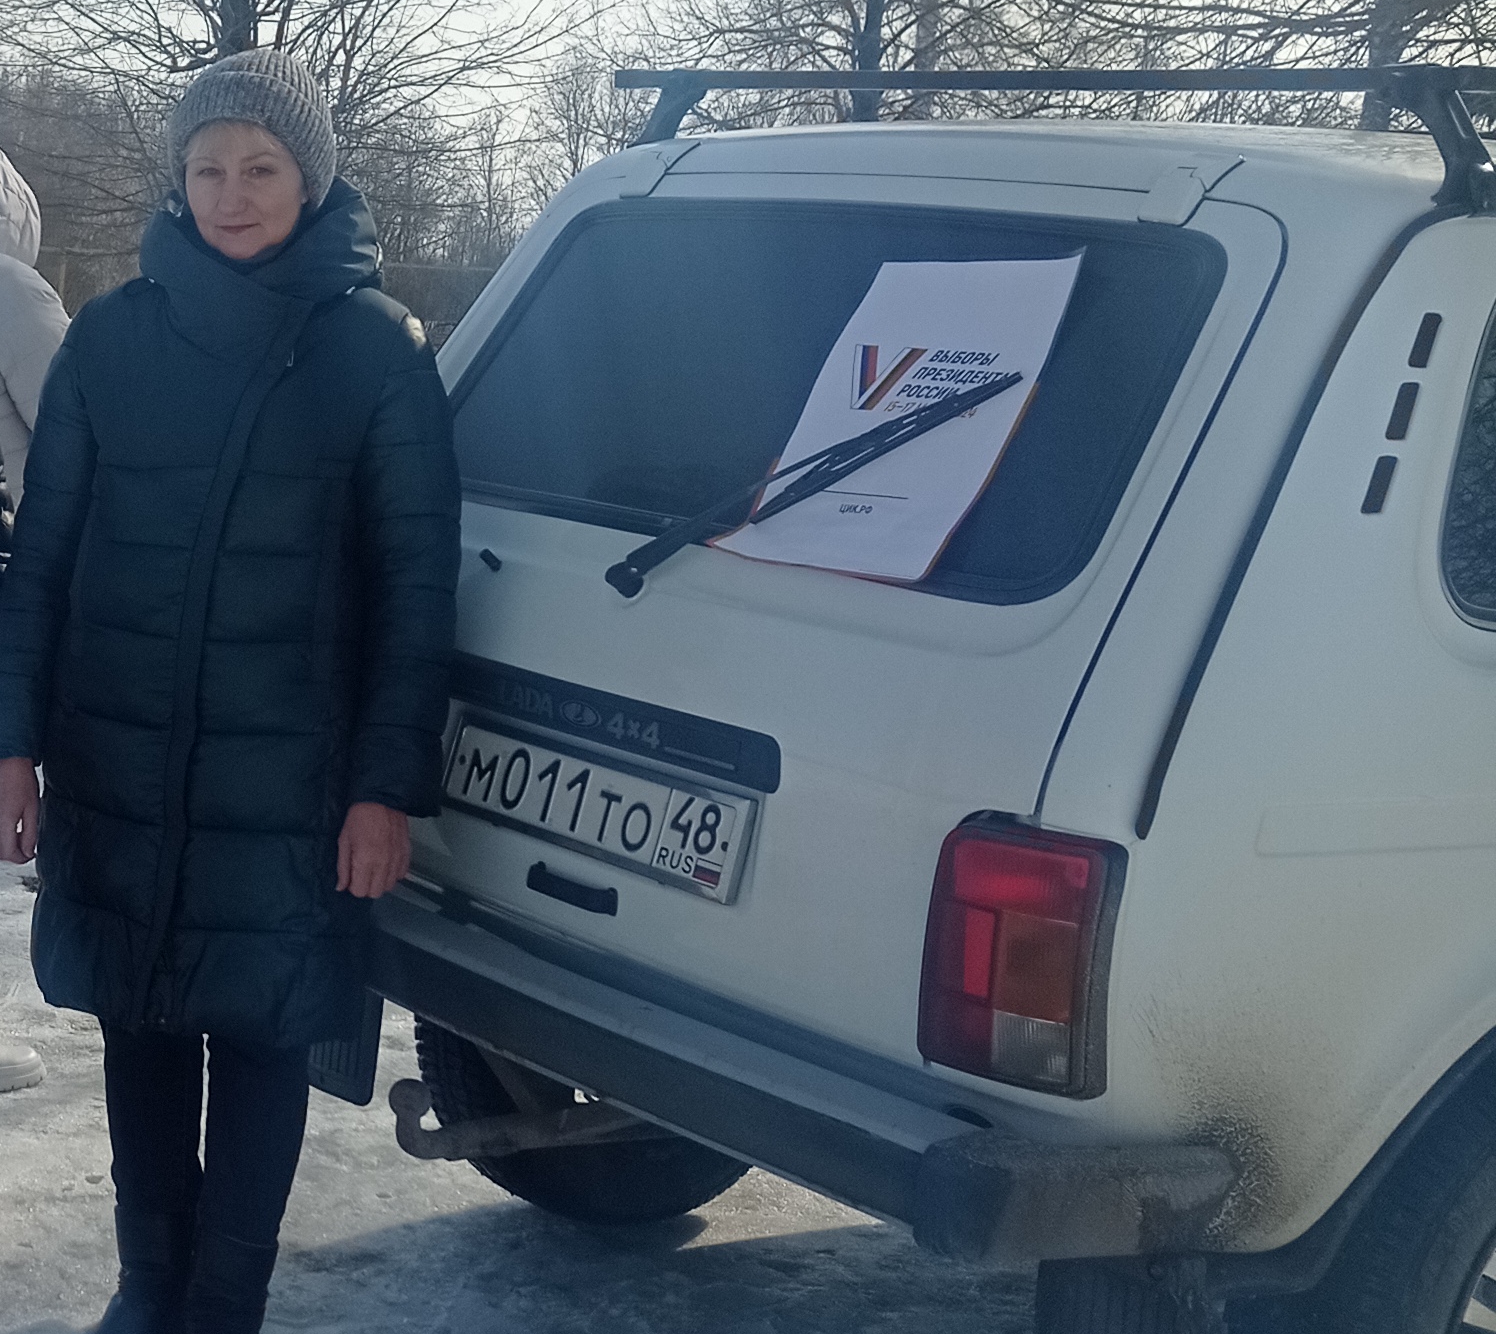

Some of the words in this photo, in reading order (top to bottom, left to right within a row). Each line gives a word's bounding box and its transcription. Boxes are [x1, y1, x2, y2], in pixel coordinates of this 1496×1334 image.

[928, 350, 1000, 366] ВЫБОРЫ
[912, 367, 1010, 385] ПРЕЗИДЕНТ
[670, 795, 723, 856] 48
[656, 845, 695, 875] RUS
